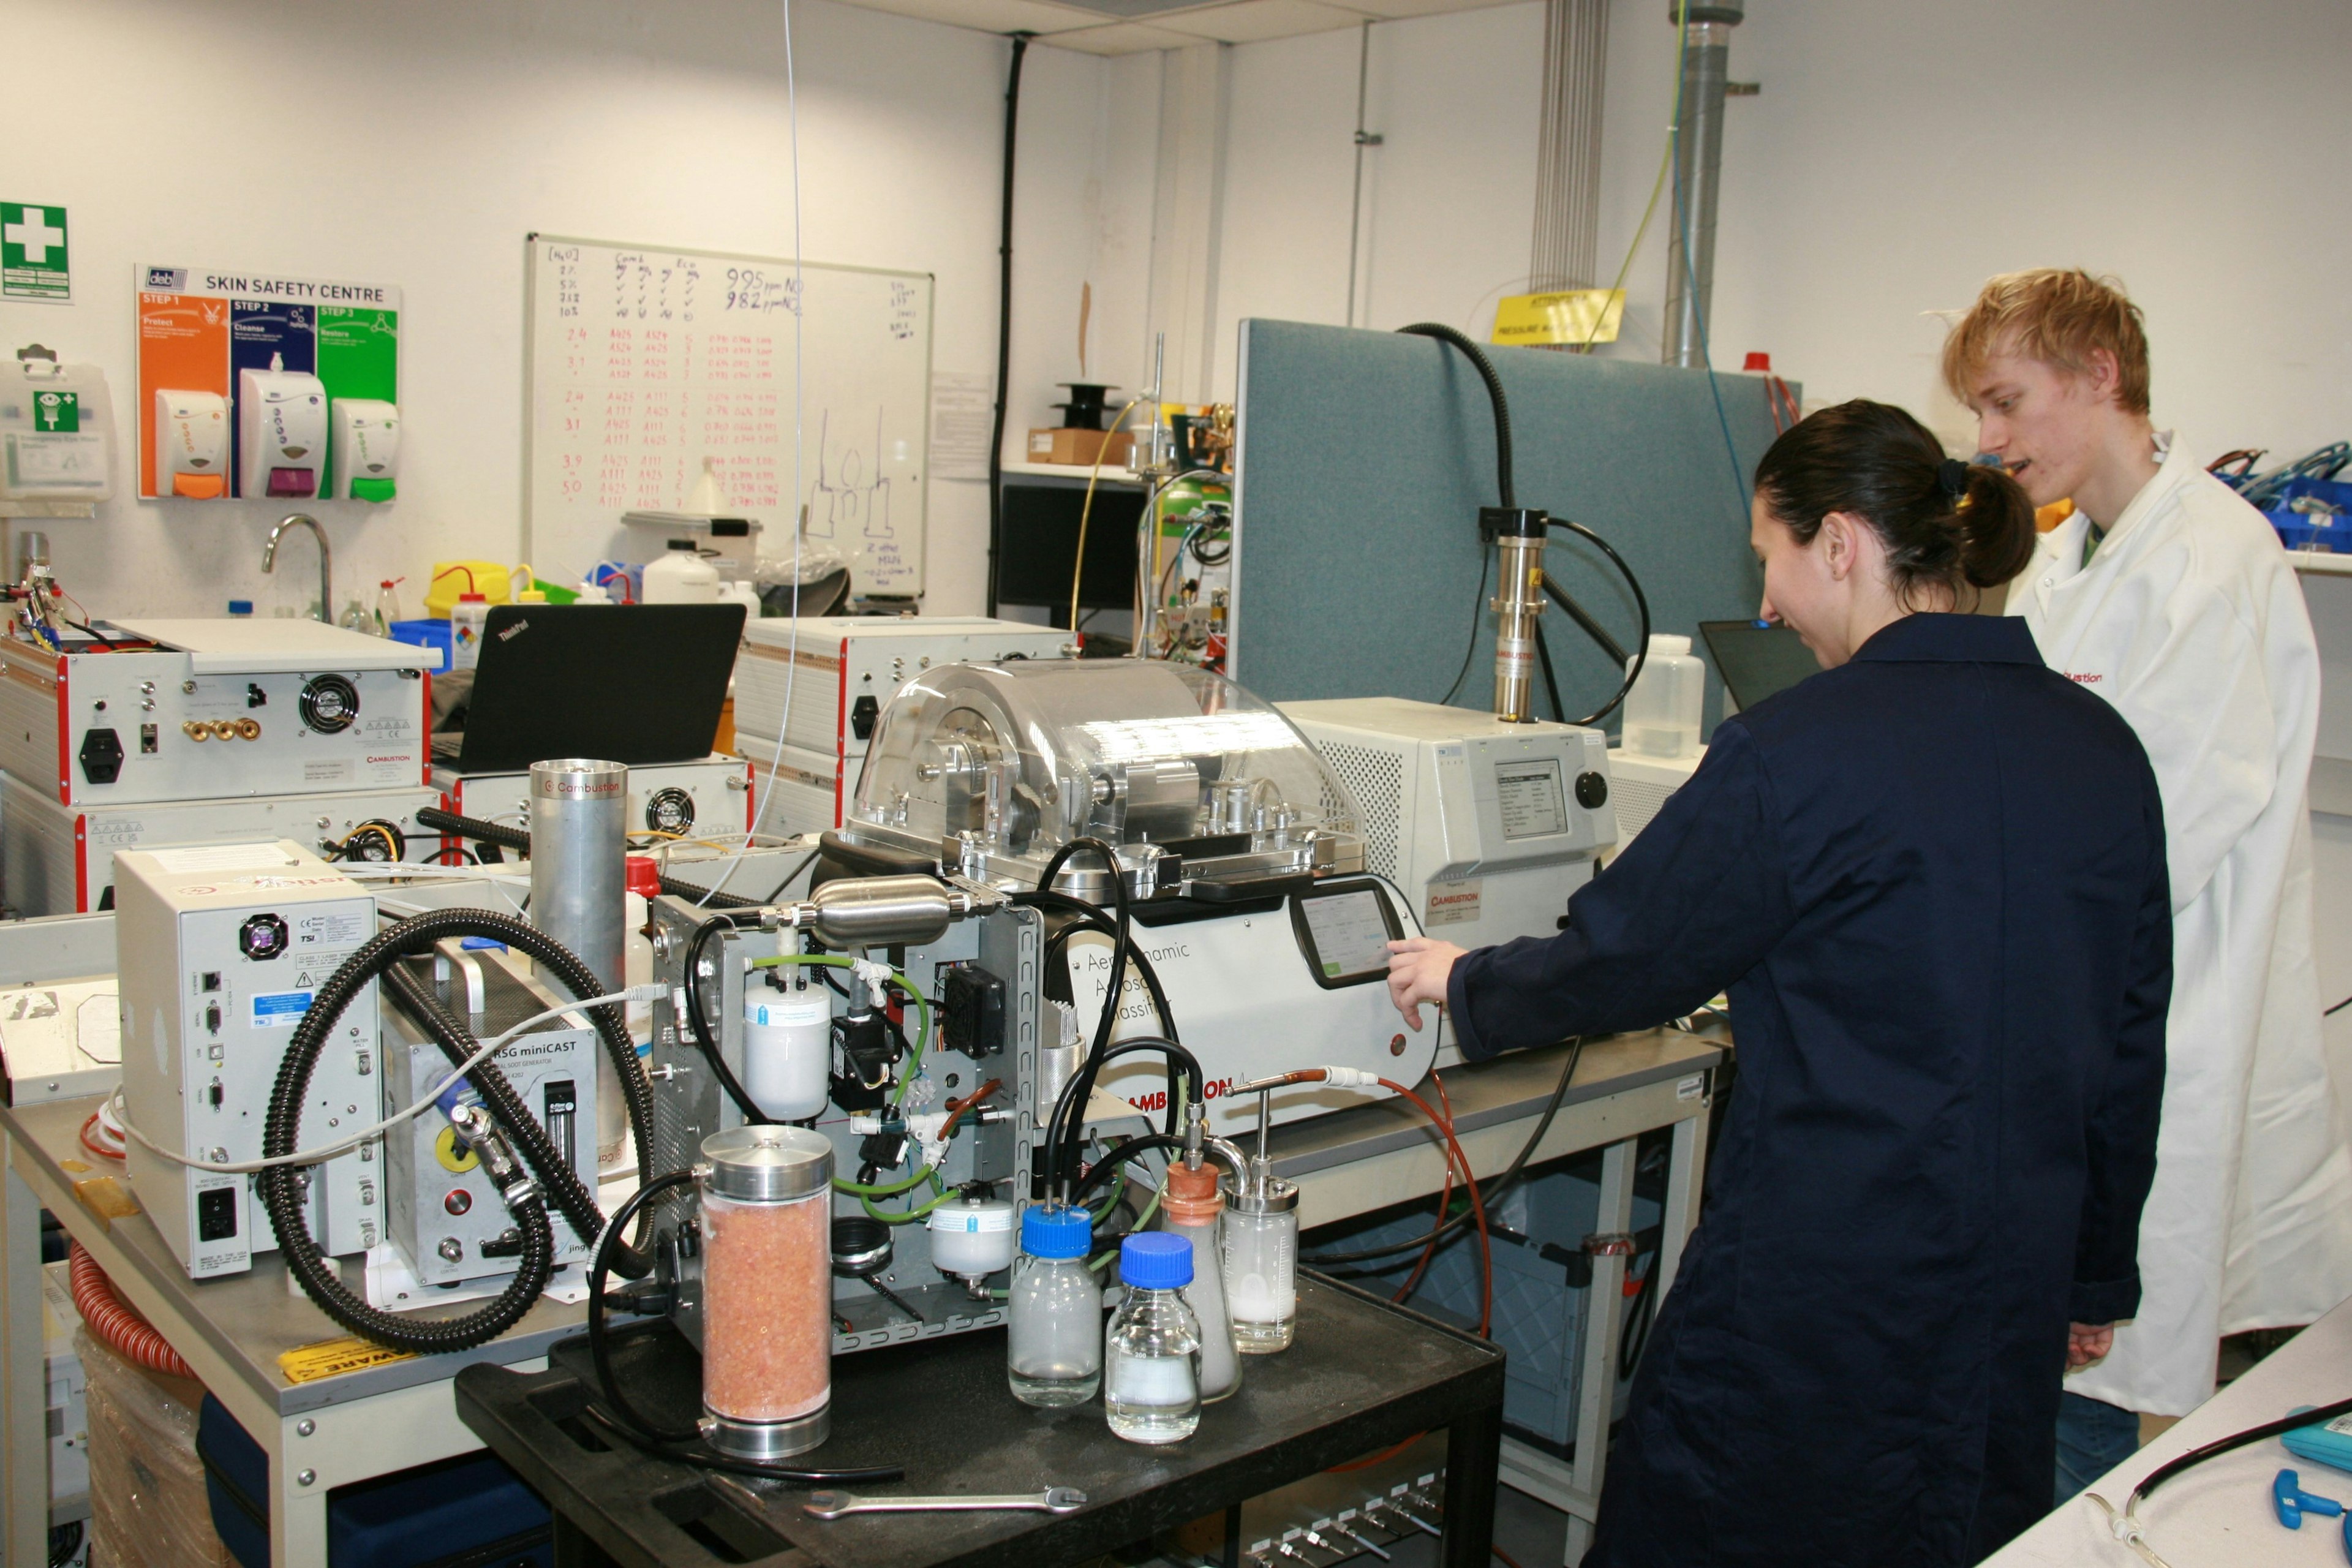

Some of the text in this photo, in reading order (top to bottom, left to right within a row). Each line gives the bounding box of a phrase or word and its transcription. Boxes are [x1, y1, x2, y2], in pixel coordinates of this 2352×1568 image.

[727, 268, 764, 291] 995
[150, 271, 384, 302] deb SKIN SAFETY CENTRE
[143, 294, 179, 305] STEP 1
[725, 291, 761, 311] 982
[234, 301, 269, 312] STEP 2
[320, 307, 354, 317] STEP 3
[143, 317, 173, 326] Protect
[234, 323, 265, 333] Cleanse
[320, 328, 350, 337] Restore
[562, 454, 582, 469] 3.9
[497, 618, 530, 642] ThinkPad
[557, 782, 619, 793] Cambustion
[1431, 892, 1479, 907] CAMBUSTION
[1088, 941, 1190, 972] Aernamic
[494, 1041, 577, 1059] RSG miniCAST
[522, 1058, 552, 1067] GENERATOR
[568, 1244, 586, 1254] jing
